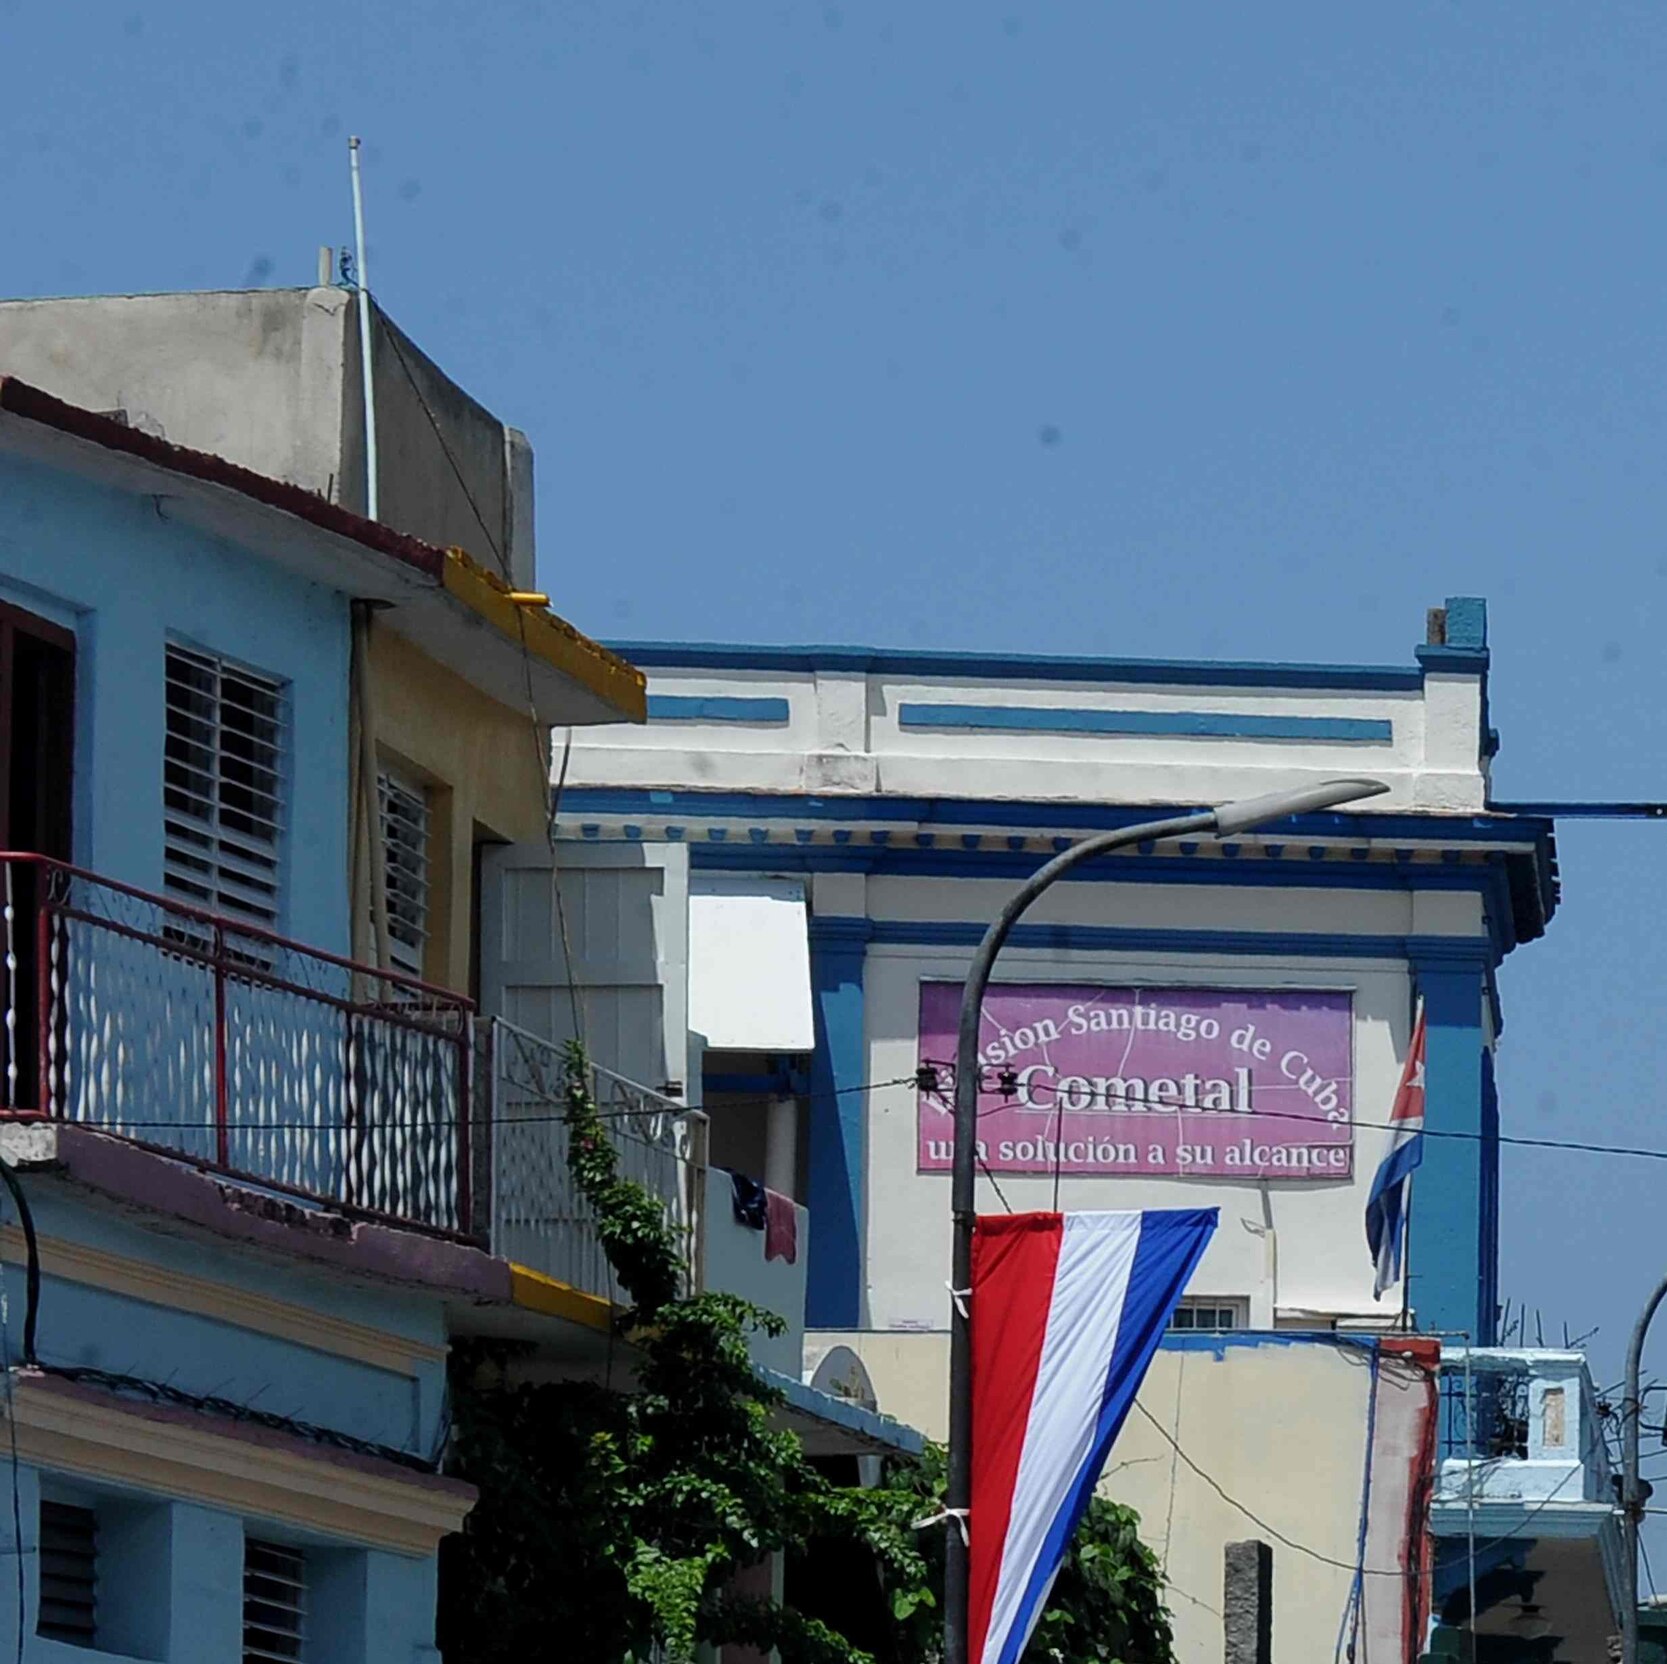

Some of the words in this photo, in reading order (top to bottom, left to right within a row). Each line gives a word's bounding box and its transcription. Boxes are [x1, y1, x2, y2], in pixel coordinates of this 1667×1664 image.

[1016, 1064, 1253, 1113] Cometal
[1066, 1002, 1220, 1041] Santiago
[1230, 1023, 1272, 1060] de
[1280, 1050, 1349, 1130] Cuba
[928, 1138, 988, 1161] ua
[998, 1135, 1138, 1164] solución
[1146, 1143, 1166, 1165] a
[1175, 1143, 1216, 1166] su
[1224, 1138, 1346, 1168] alcance
